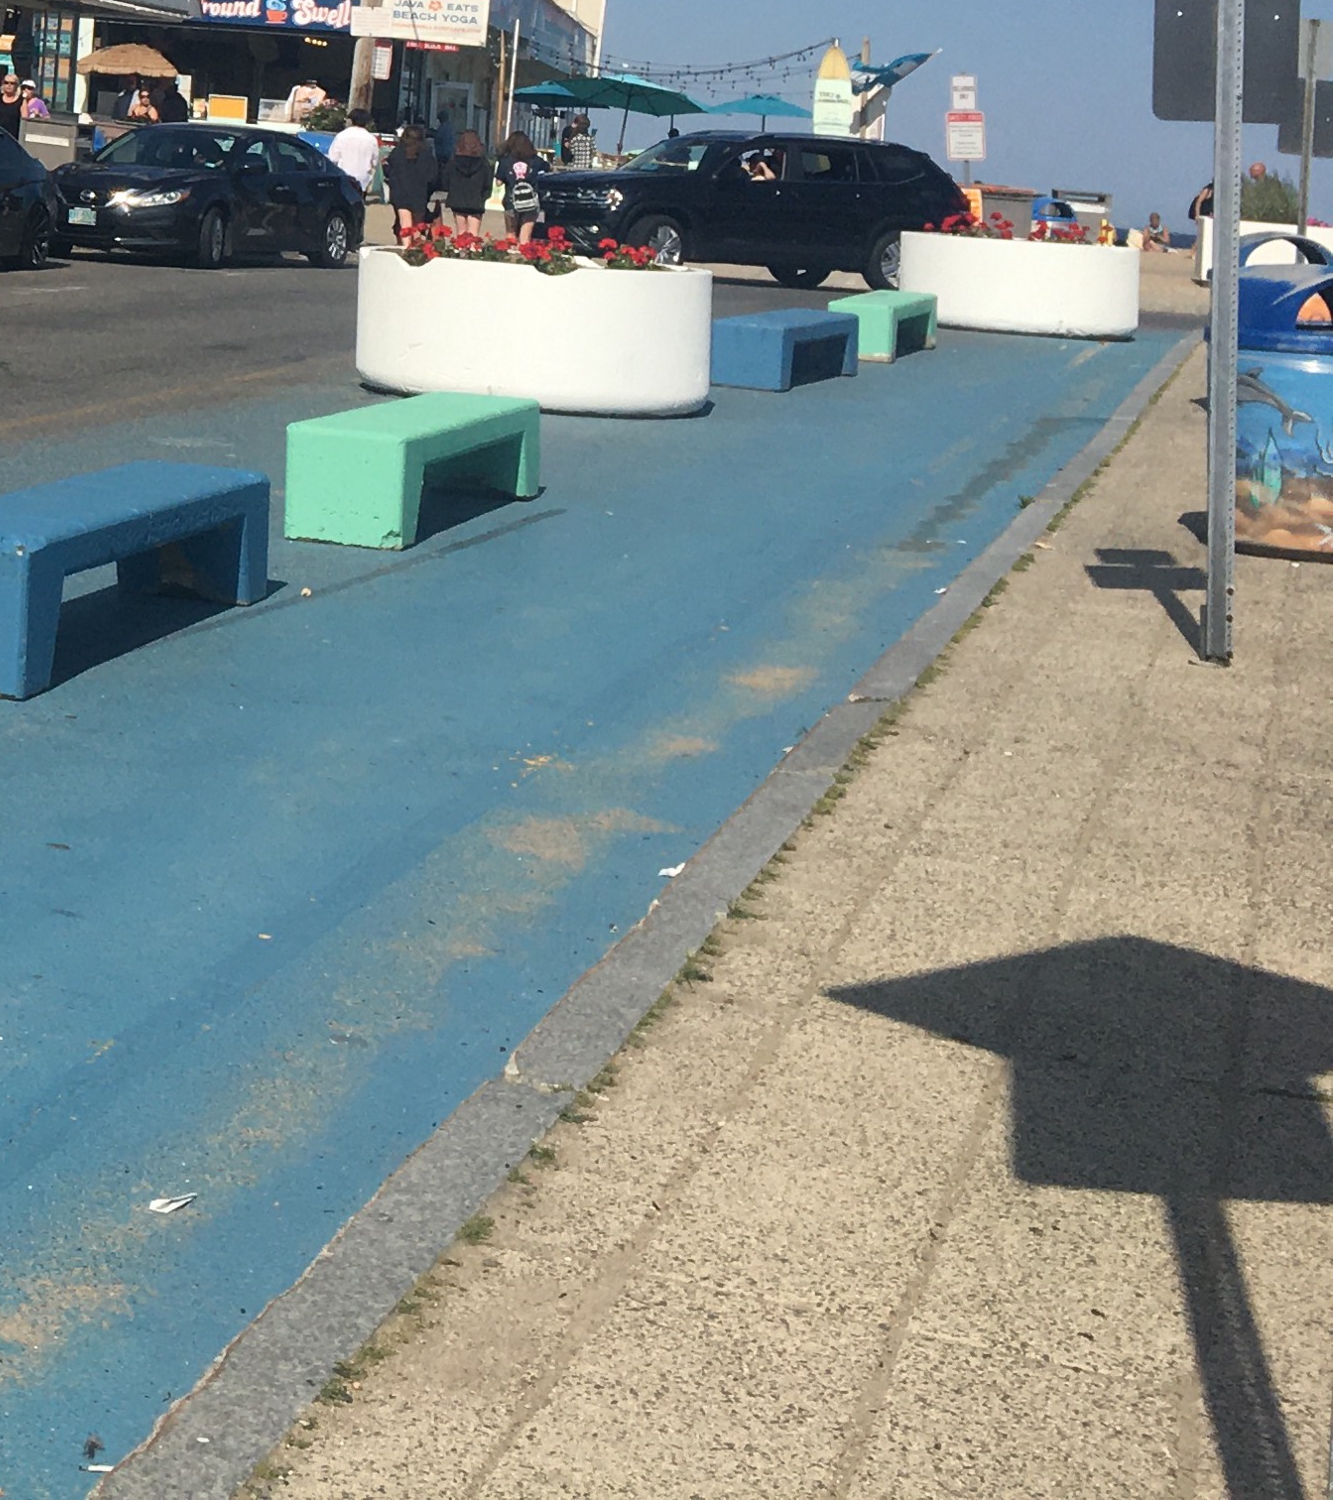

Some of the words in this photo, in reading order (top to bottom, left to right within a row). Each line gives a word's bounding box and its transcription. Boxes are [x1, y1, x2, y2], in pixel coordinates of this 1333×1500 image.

[394, 0, 425, 10] JAVA
[446, 2, 480, 13] EATS
[392, 10, 438, 22] BEACH
[441, 13, 479, 26] YOGA
